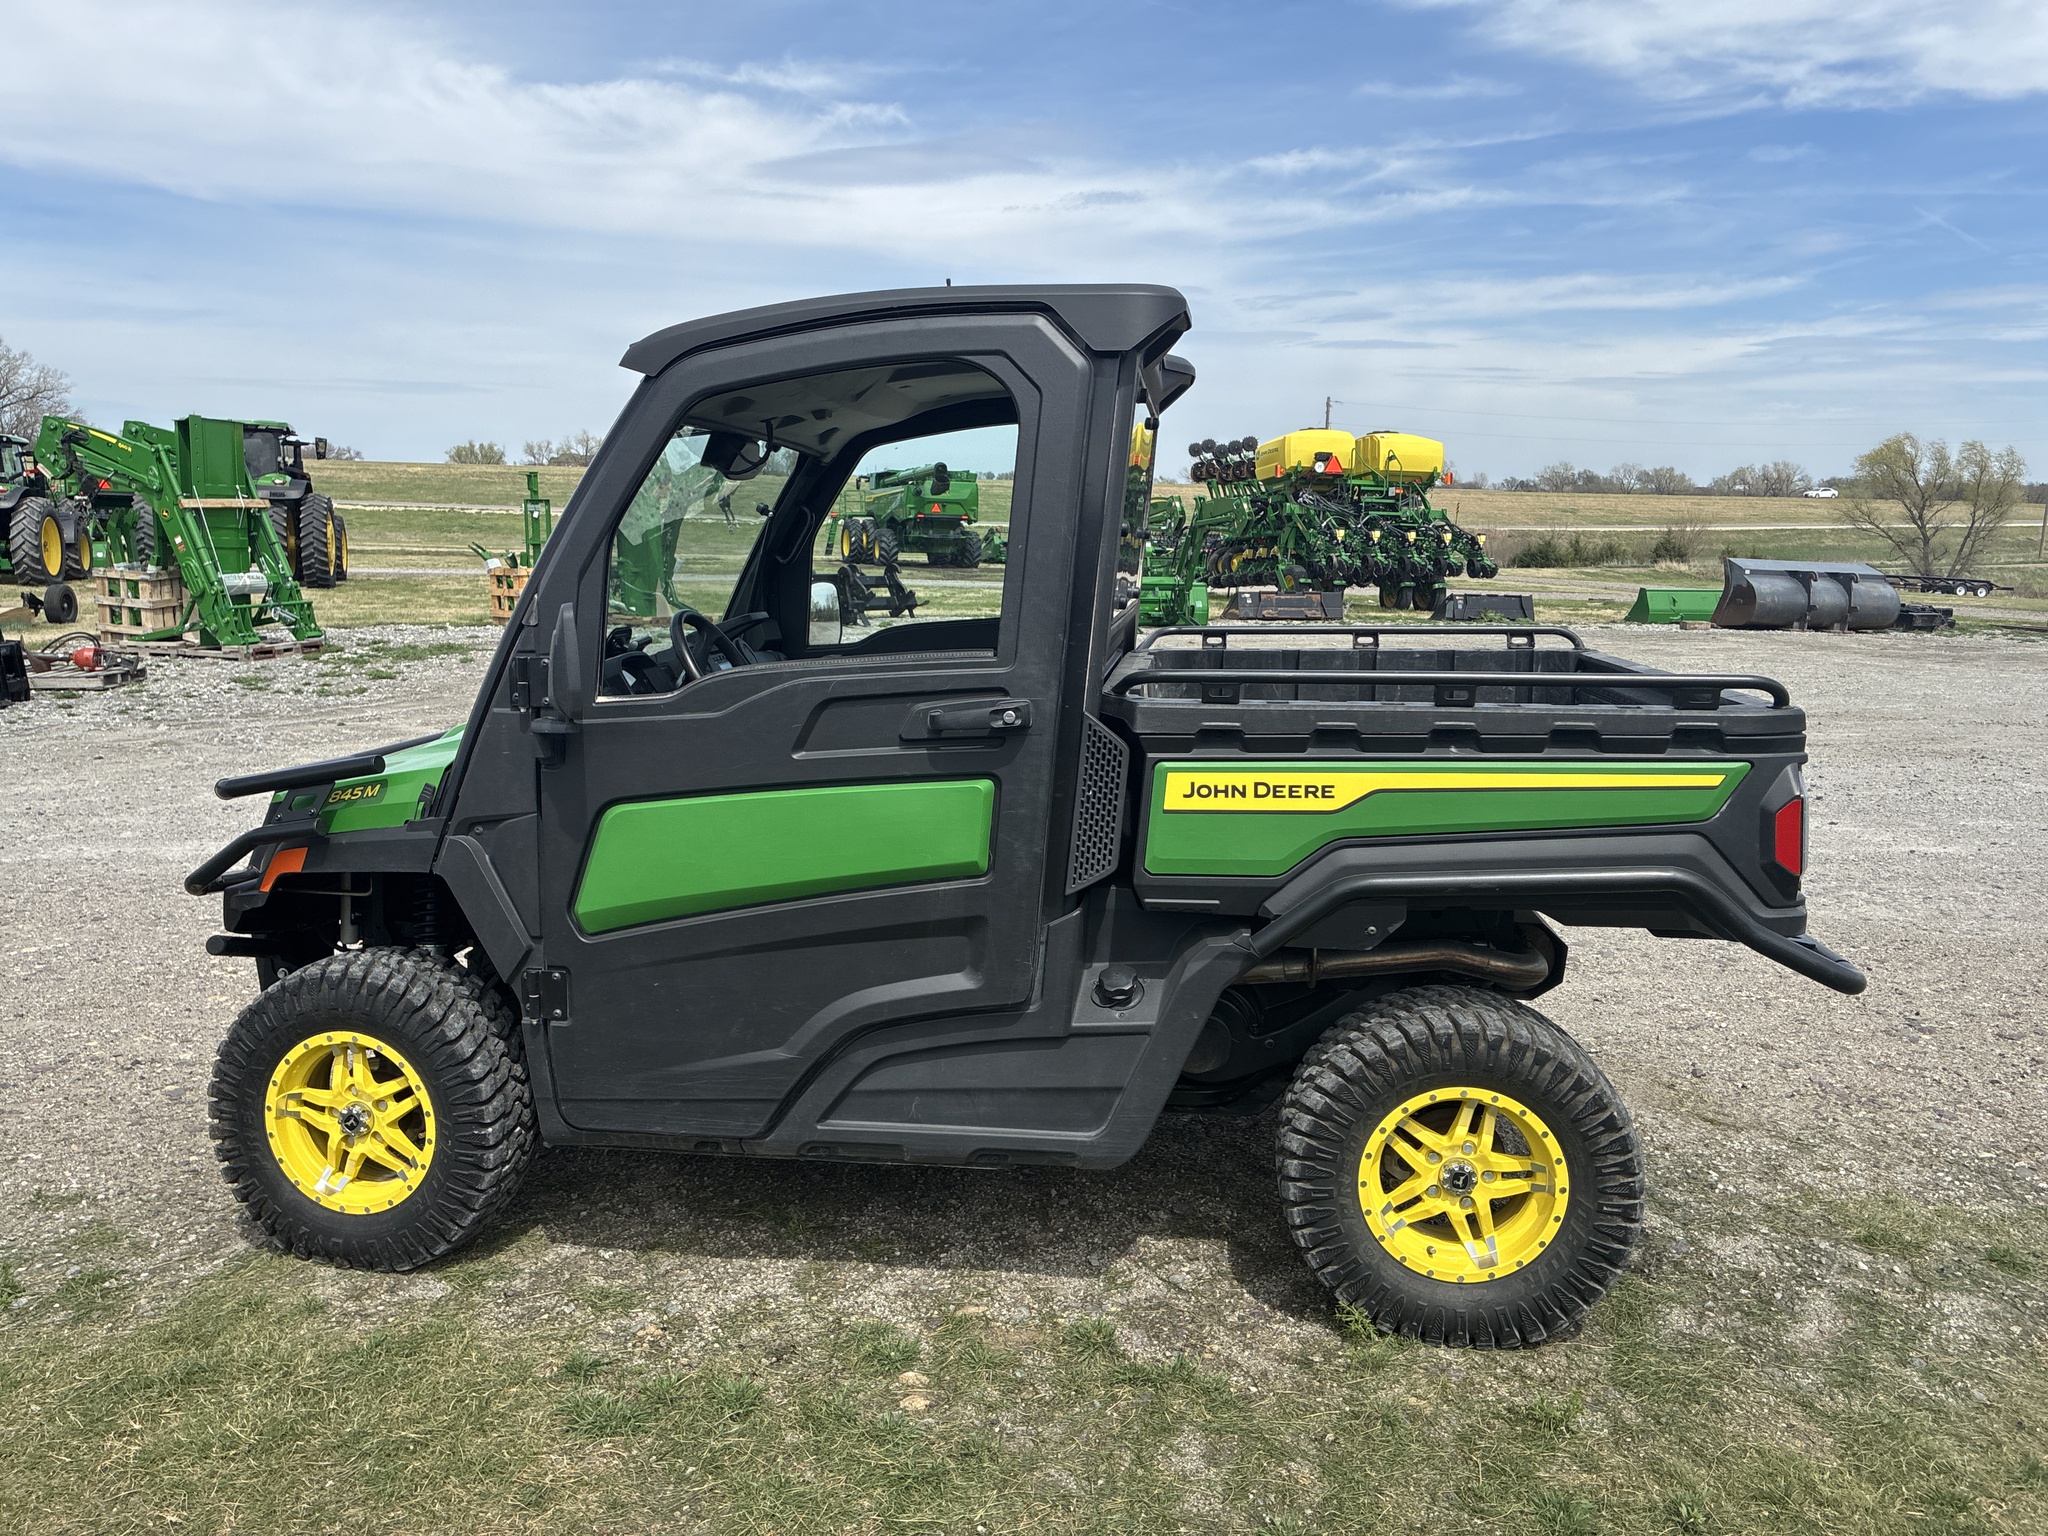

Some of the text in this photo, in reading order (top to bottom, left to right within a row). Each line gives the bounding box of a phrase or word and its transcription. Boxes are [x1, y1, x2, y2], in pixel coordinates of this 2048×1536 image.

[1353, 485, 1359, 500] 2
[328, 783, 382, 803] 845M
[1182, 781, 1335, 799] JOHN DEERE
